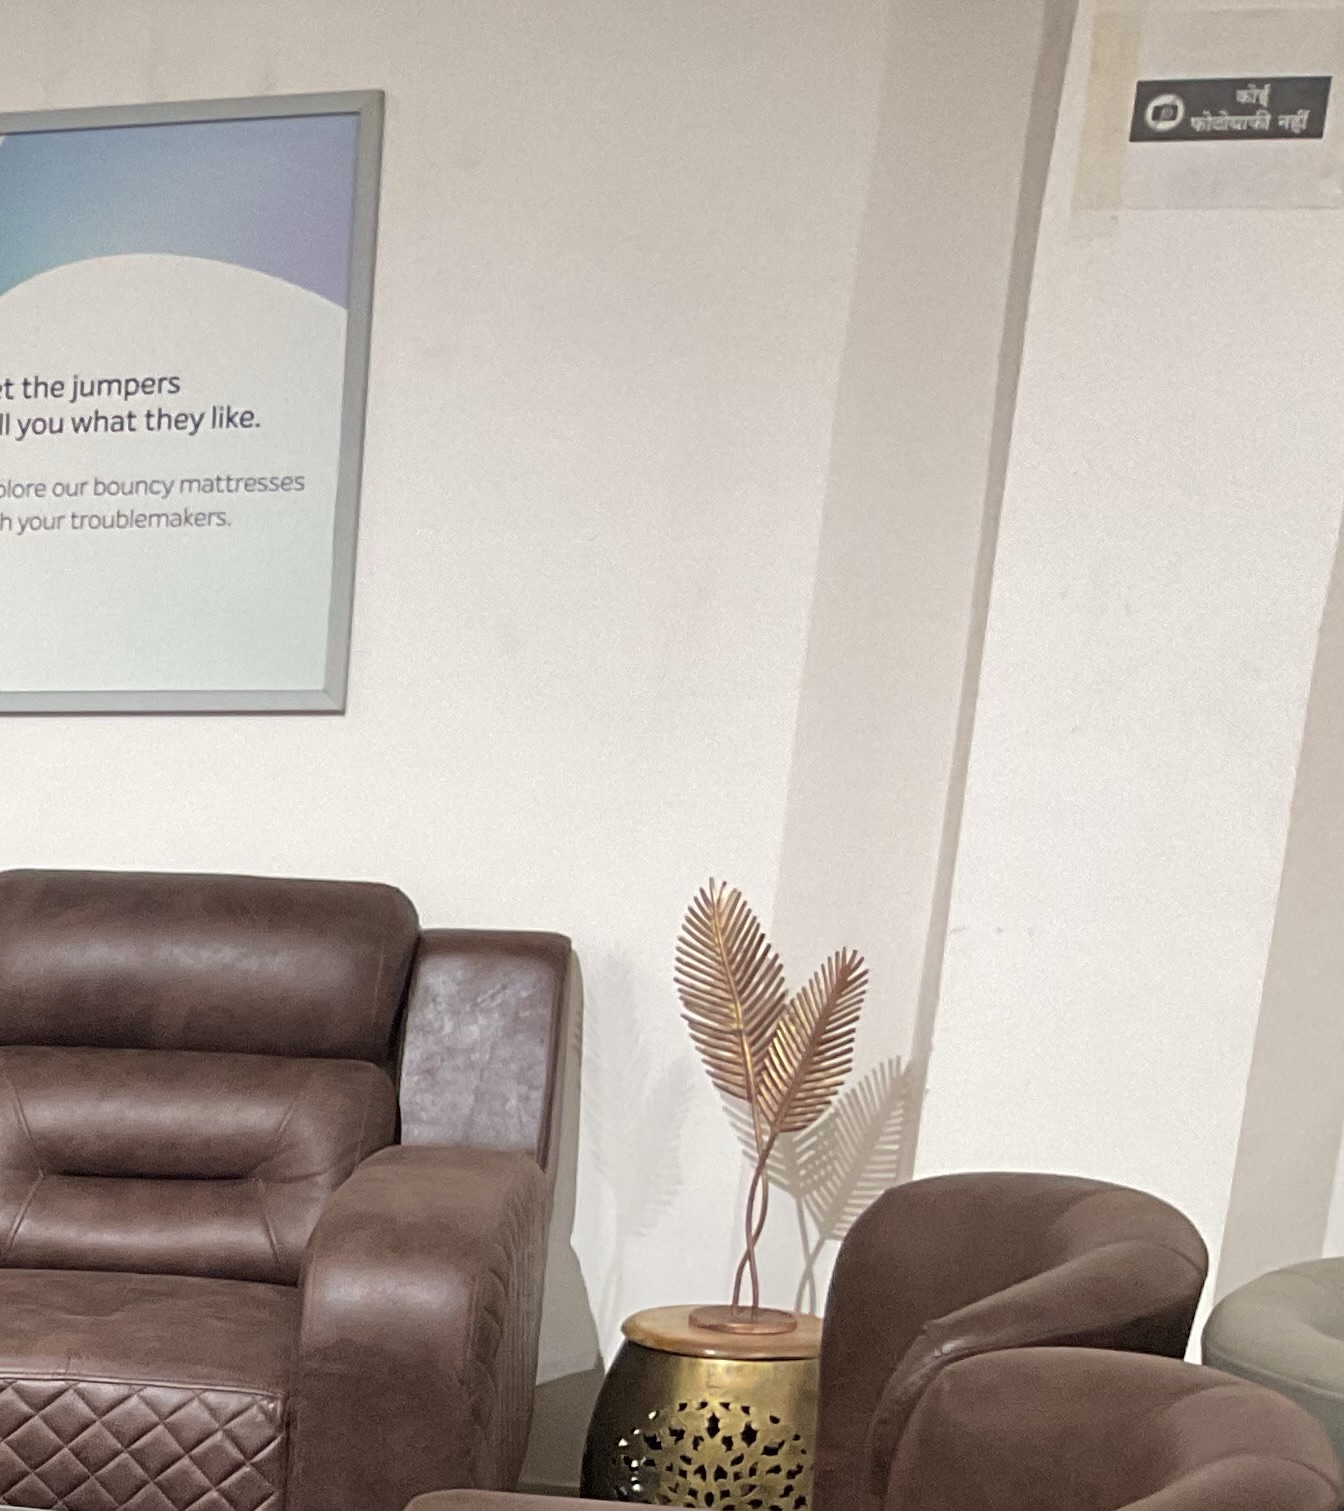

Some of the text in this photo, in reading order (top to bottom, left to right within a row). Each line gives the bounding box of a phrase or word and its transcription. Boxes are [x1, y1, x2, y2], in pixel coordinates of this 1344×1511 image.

[22, 376, 65, 400] the
[69, 374, 181, 404] jumpers
[14, 416, 64, 442] you
[71, 409, 137, 435] what
[145, 408, 205, 436] they
[211, 405, 261, 430] like.
[52, 481, 87, 498] our
[92, 476, 175, 501] bouncy
[179, 473, 305, 495] mattresses
[15, 512, 64, 535] your
[70, 508, 232, 530] troublemakers.
